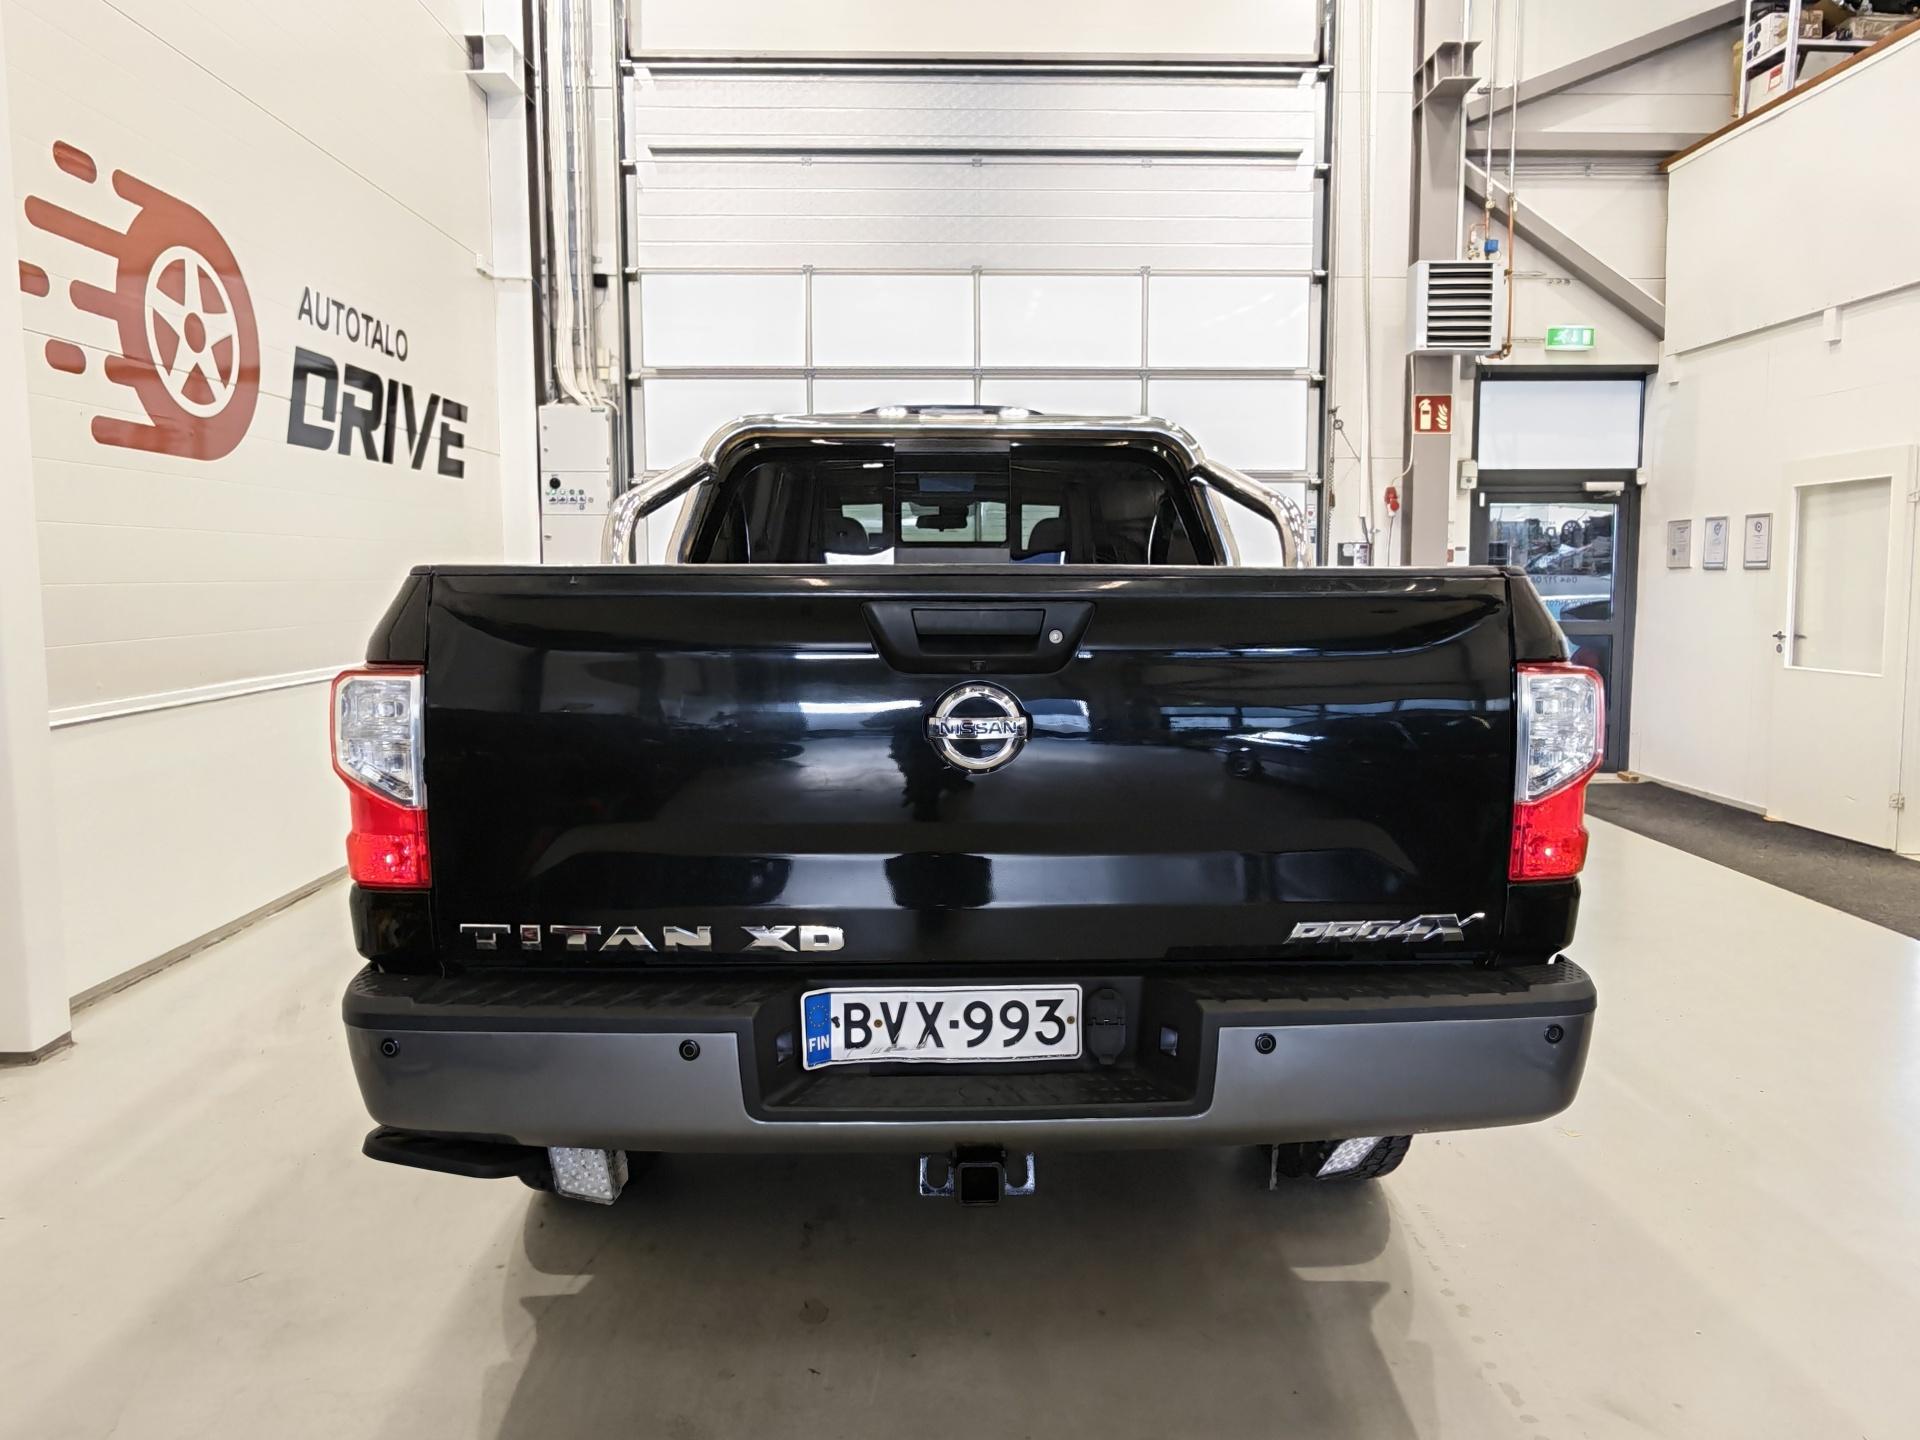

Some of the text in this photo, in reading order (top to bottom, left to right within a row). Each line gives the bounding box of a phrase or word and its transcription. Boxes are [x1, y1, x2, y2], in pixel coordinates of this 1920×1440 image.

[298, 286, 408, 362] AUTOTALO
[287, 346, 468, 479] DRIVE
[940, 721, 1017, 735] NISSAN
[459, 924, 844, 952] TITAN XD
[808, 1033, 830, 1053] FIN
[843, 998, 1066, 1049] BVX-993
